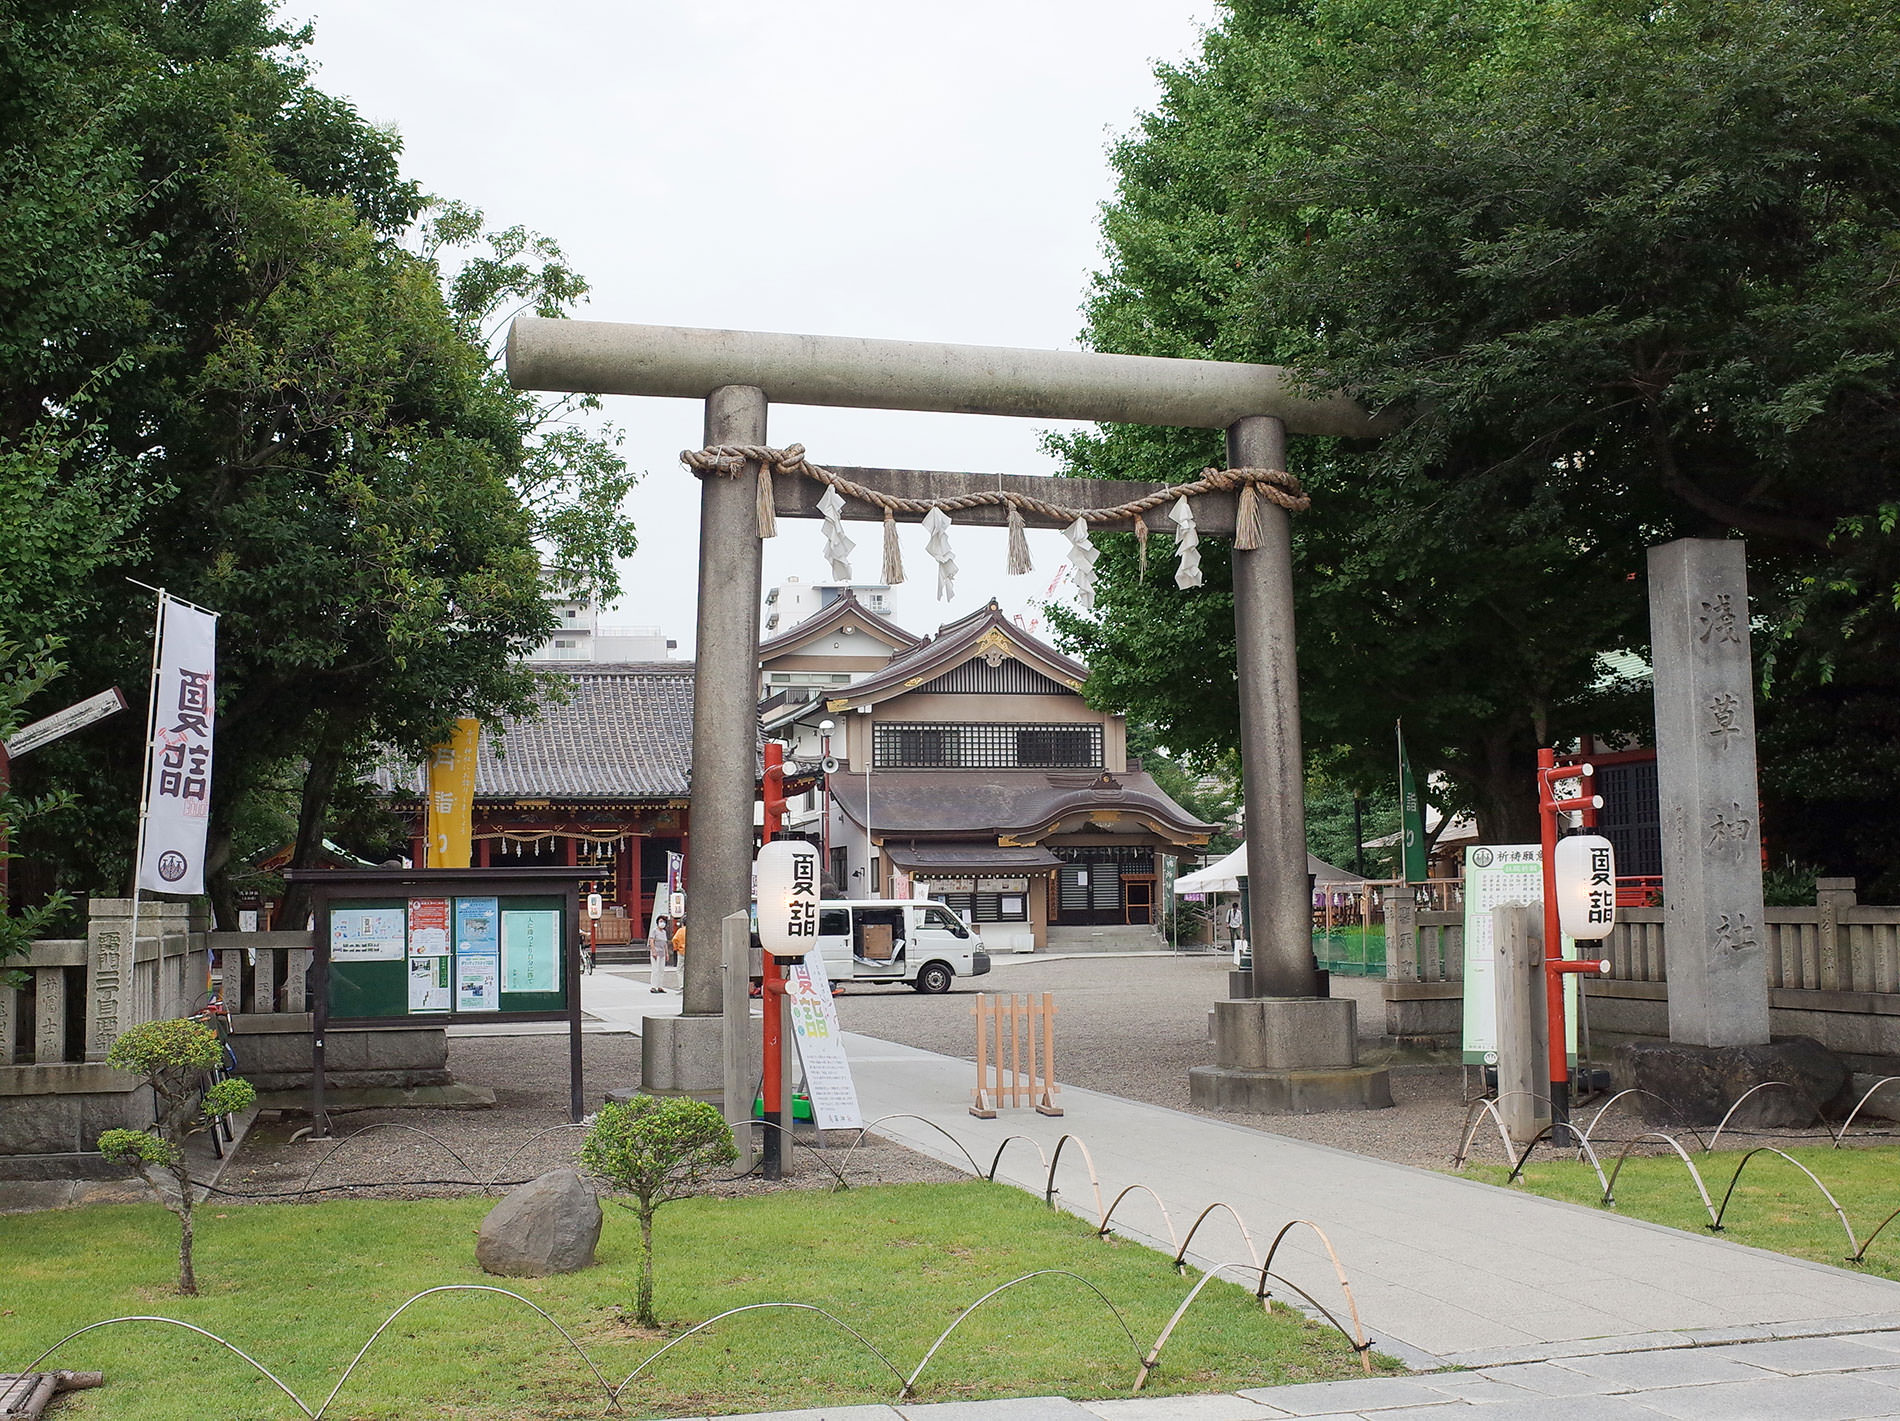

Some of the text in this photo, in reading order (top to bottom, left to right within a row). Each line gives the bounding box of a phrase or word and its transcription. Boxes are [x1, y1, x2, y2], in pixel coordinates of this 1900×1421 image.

[159, 667, 210, 801] 夏詣
[788, 853, 816, 937] 夏詣
[1588, 847, 1613, 924] 夏詣
[795, 963, 829, 1038] 夏詣
